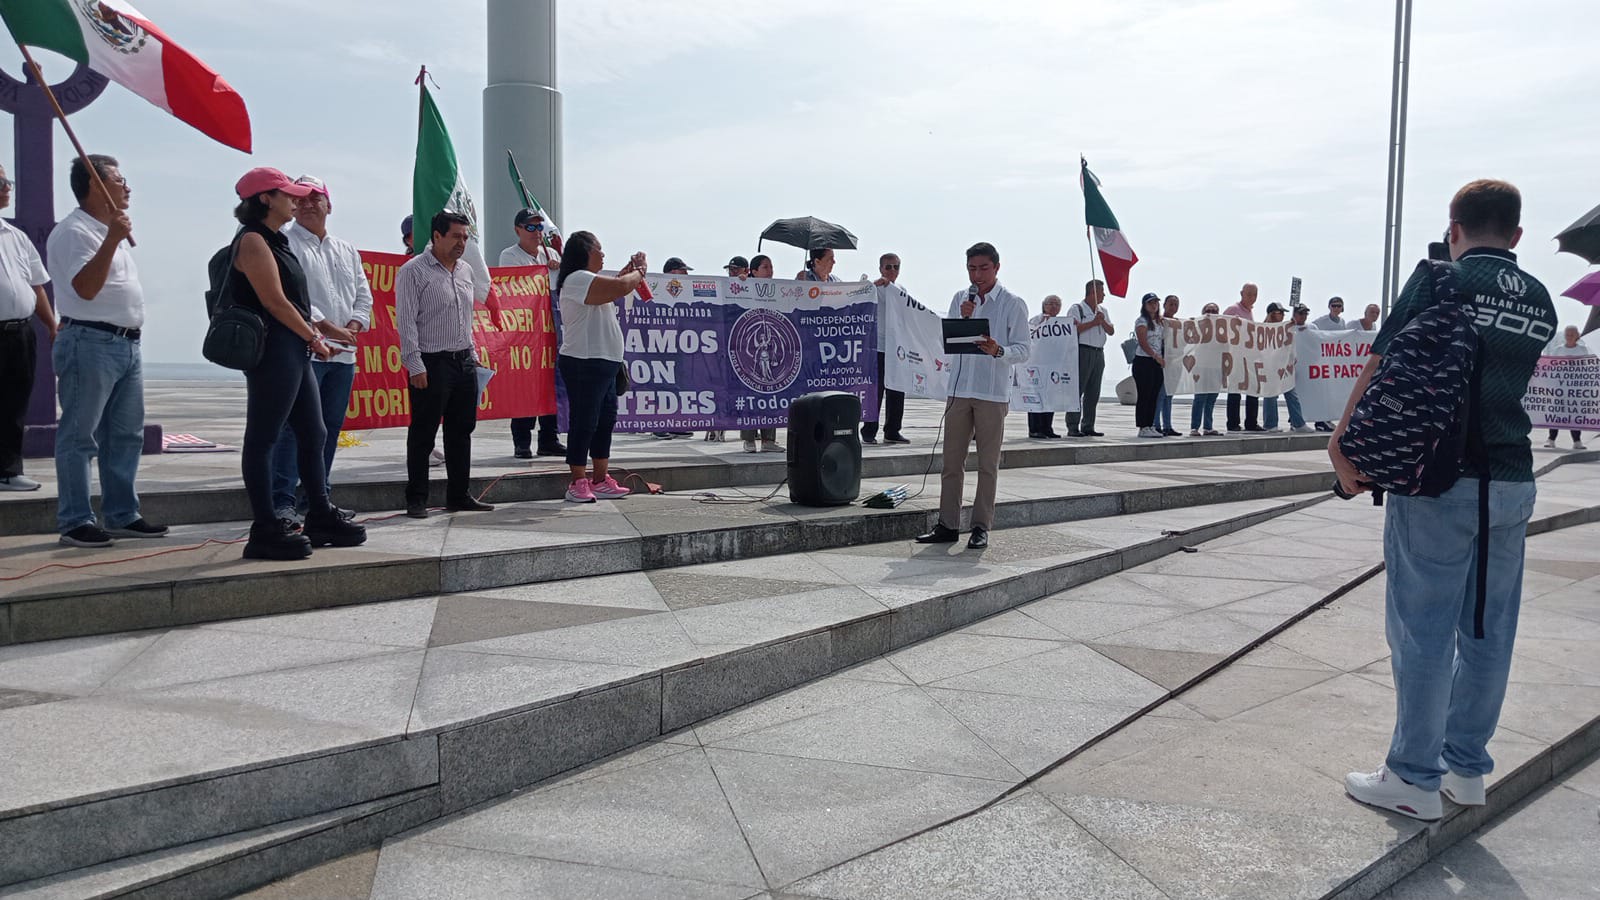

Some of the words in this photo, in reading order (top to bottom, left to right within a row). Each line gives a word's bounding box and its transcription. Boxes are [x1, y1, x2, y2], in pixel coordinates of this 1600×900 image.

[492, 274, 550, 297] STAMO
[655, 307, 712, 318] ORGANIZADA
[1475, 294, 1513, 310] MILAN
[1516, 304, 1547, 318] ITALY
[800, 314, 874, 325] #INDEPENDENCIA
[814, 325, 867, 338] JUDICIAL
[1168, 317, 1242, 349] TODOS
[1244, 322, 1294, 351] SOMOS
[625, 329, 718, 354] AMOS
[819, 340, 863, 364] PJF
[1355, 343, 1373, 357] VA
[510, 346, 532, 370] NO
[624, 360, 676, 384] ON
[820, 368, 829, 376] MI
[831, 367, 855, 375] APOYO
[1308, 364, 1330, 379] DE
[1542, 365, 1600, 373] CIUDADANOS
[740, 373, 764, 390] JUDICIAL
[807, 378, 837, 387] PODER
[838, 376, 872, 386] JUDICIAL
[1528, 386, 1564, 397] IERNO
[1567, 389, 1599, 398] RECU
[345, 387, 409, 418] UTORI
[617, 391, 716, 415] TEDES
[1524, 396, 1552, 405] PODER
[1548, 405, 1566, 413] QUE
[615, 418, 715, 431] ntrapesoNacional
[737, 415, 789, 426] #UnidosSo
[1545, 414, 1571, 424] Wael
